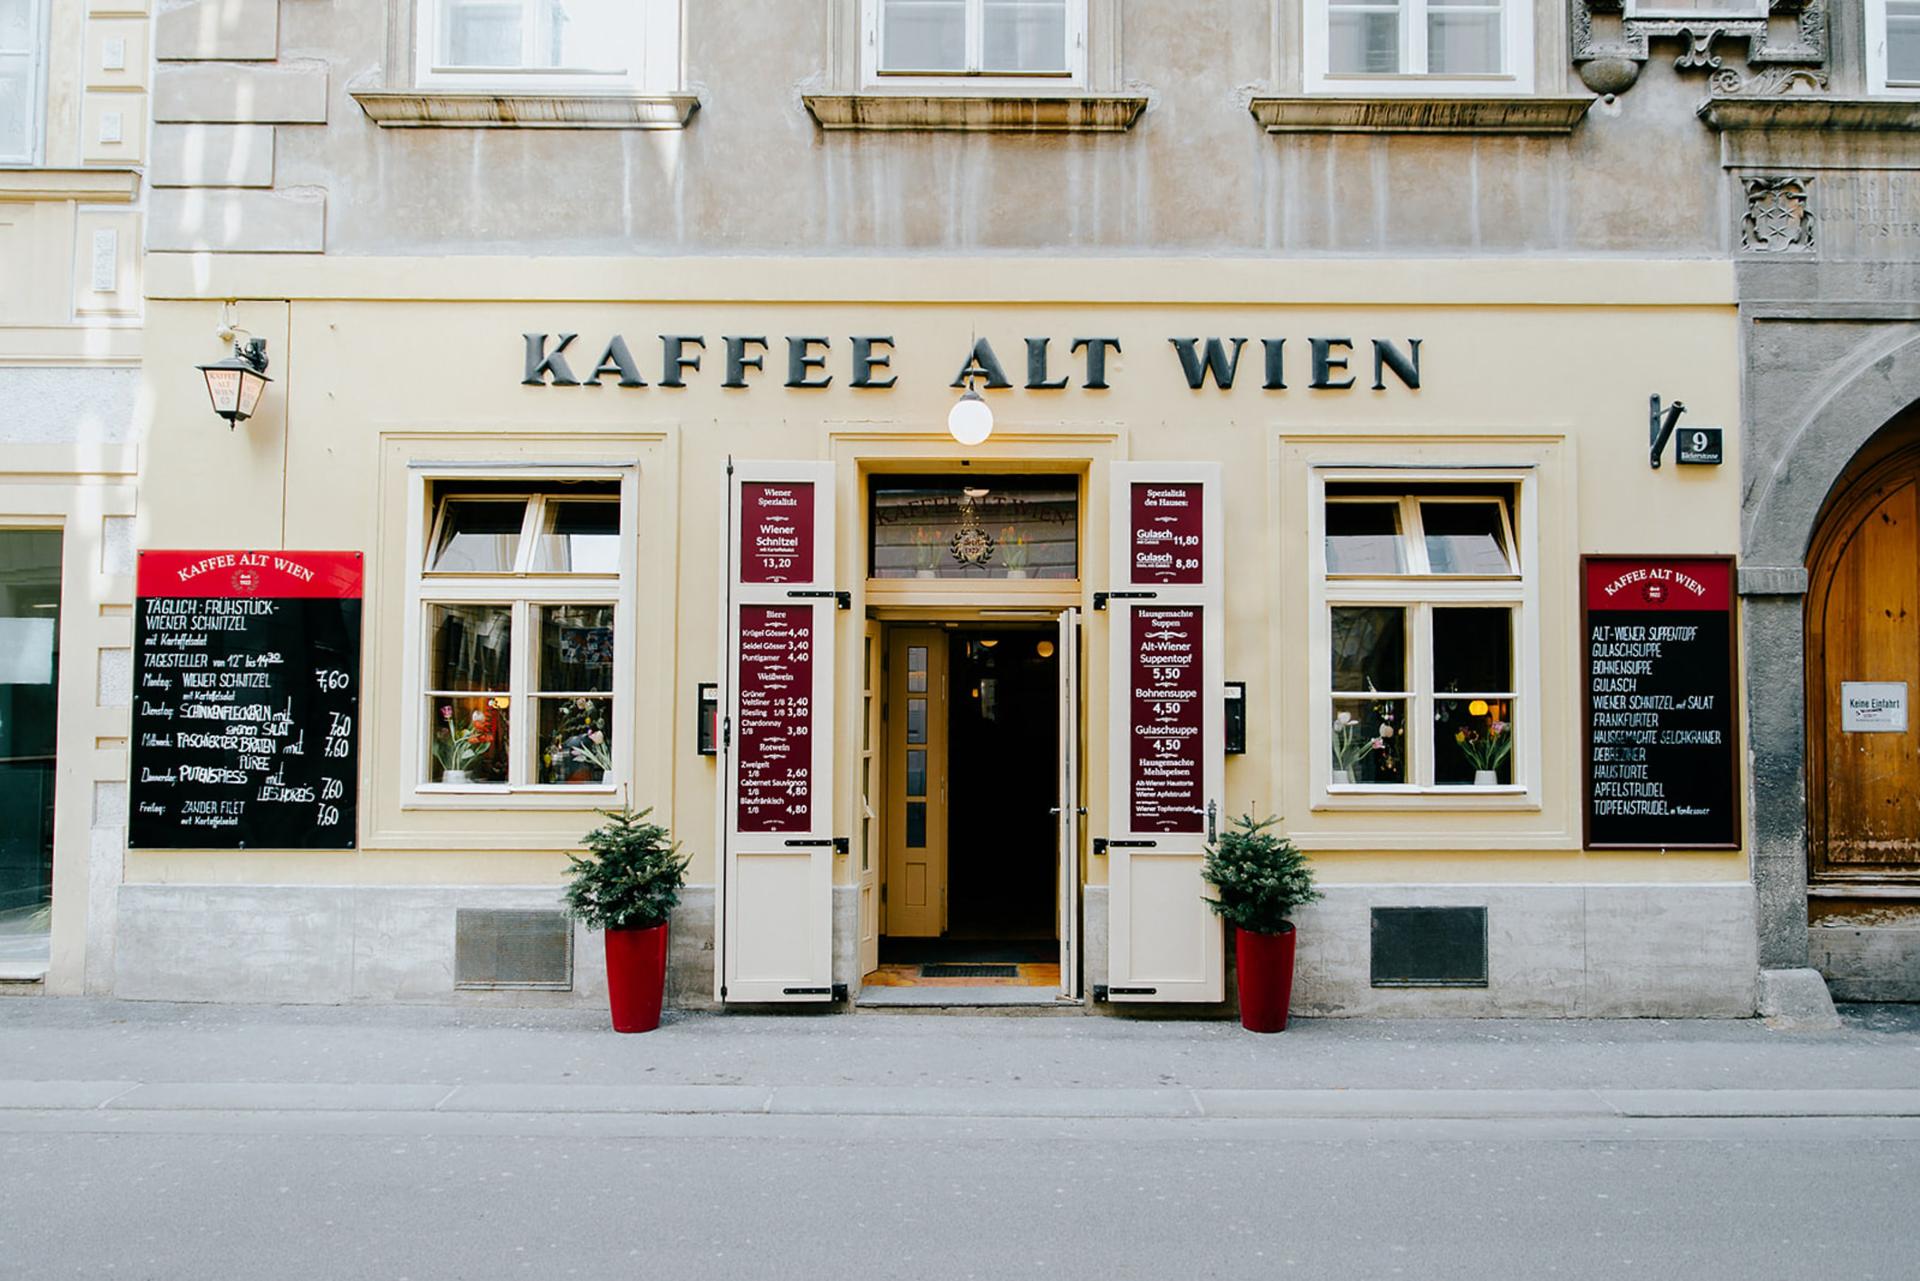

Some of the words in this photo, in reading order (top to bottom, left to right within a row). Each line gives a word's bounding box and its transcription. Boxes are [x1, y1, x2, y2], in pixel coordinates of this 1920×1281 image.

[521, 333, 898, 388] KAFFEE
[949, 337, 1122, 389] ALT
[1168, 337, 1423, 390] WIEN
[1692, 431, 1708, 452] 9
[764, 488, 792, 496] Wiener
[1147, 489, 1186, 498] Spezialität
[758, 497, 798, 507] Spezialität
[1144, 498, 1157, 506] des
[760, 524, 795, 534] Wiener
[756, 537, 798, 546] Schnitzel
[1136, 529, 1172, 538] Gulasch
[1173, 536, 1199, 546] 11,80
[763, 558, 792, 569] 13,20
[1136, 552, 1172, 562] Gulasch
[1175, 559, 1198, 570] 8,80
[177, 554, 236, 582] KAFFEE
[239, 554, 270, 567] ALT
[274, 557, 315, 582] WIEN
[1604, 569, 1647, 596] KAFFEE
[1649, 568, 1672, 579] ALT
[1675, 572, 1706, 596] WIEN
[766, 610, 786, 618] Biere
[145, 615, 187, 630] WIENER
[191, 615, 248, 630] SCHNITZEL
[1151, 619, 1180, 628] Suppen
[788, 628, 808, 638] 4,40
[1592, 626, 1646, 641] ALT-WIENER
[144, 634, 158, 646] mit
[742, 642, 762, 650] Seidel
[763, 642, 786, 650] Gösser
[788, 641, 808, 651] 3,40
[1140, 642, 1191, 651] Alt-Wiener
[1592, 642, 1662, 658] GULASCHSUPPE
[144, 653, 208, 668] TAGESTELLER
[245, 653, 256, 668] bis
[787, 653, 808, 662] 4,40
[1140, 653, 1192, 664] Suppentopf
[1592, 660, 1653, 675] BOHNENSUPPE
[1153, 668, 1180, 680] 5,50
[182, 672, 216, 688] WIENER
[219, 672, 271, 688] SCHNITZEL
[315, 668, 349, 692] 7,60
[1593, 677, 1636, 692] GULASCH
[1135, 688, 1197, 698] Bohnensuppe
[787, 697, 808, 707] 2,40
[1593, 695, 1626, 710] WIENER
[1628, 695, 1674, 710] SCHNITZEL
[1687, 695, 1714, 710] SALAT
[1850, 698, 1870, 708] Keine
[1871, 698, 1900, 708] Einfahrt
[272, 696, 294, 724] mit
[787, 707, 808, 718] 3,80
[1152, 702, 1180, 715] 4,50
[741, 719, 782, 728] Chardonnay
[1593, 712, 1659, 728] FRANKFURTER
[262, 721, 290, 736] SALAT
[741, 727, 754, 735] 1/8
[787, 726, 808, 736] 3,80
[1135, 724, 1198, 735] Gulaschsuppe
[238, 737, 276, 754] BRATEN
[282, 729, 304, 754] mit
[325, 737, 349, 758] 7,60
[759, 743, 790, 751] Rotwein
[1152, 739, 1180, 752] 4,50
[741, 760, 770, 768] Zweigelt
[265, 761, 286, 786] mit
[748, 770, 760, 778] 1/8
[786, 768, 808, 778] 2,60
[1143, 767, 1190, 777] Mehlspeisen
[321, 777, 343, 800] 7,60
[772, 779, 806, 788] Sauvignon
[748, 788, 760, 796] 1/8
[786, 787, 808, 797] 4,80
[1594, 782, 1664, 798] APFELSTRUDEL
[747, 806, 760, 814] 1/8
[786, 805, 808, 815] 4,80
[1594, 800, 1670, 815] TOPFENSTRUDEL
[139, 801, 166, 816] Freitag:
[181, 801, 218, 814] ZANDER
[220, 801, 246, 814] FILET
[317, 802, 339, 826] 7,60
